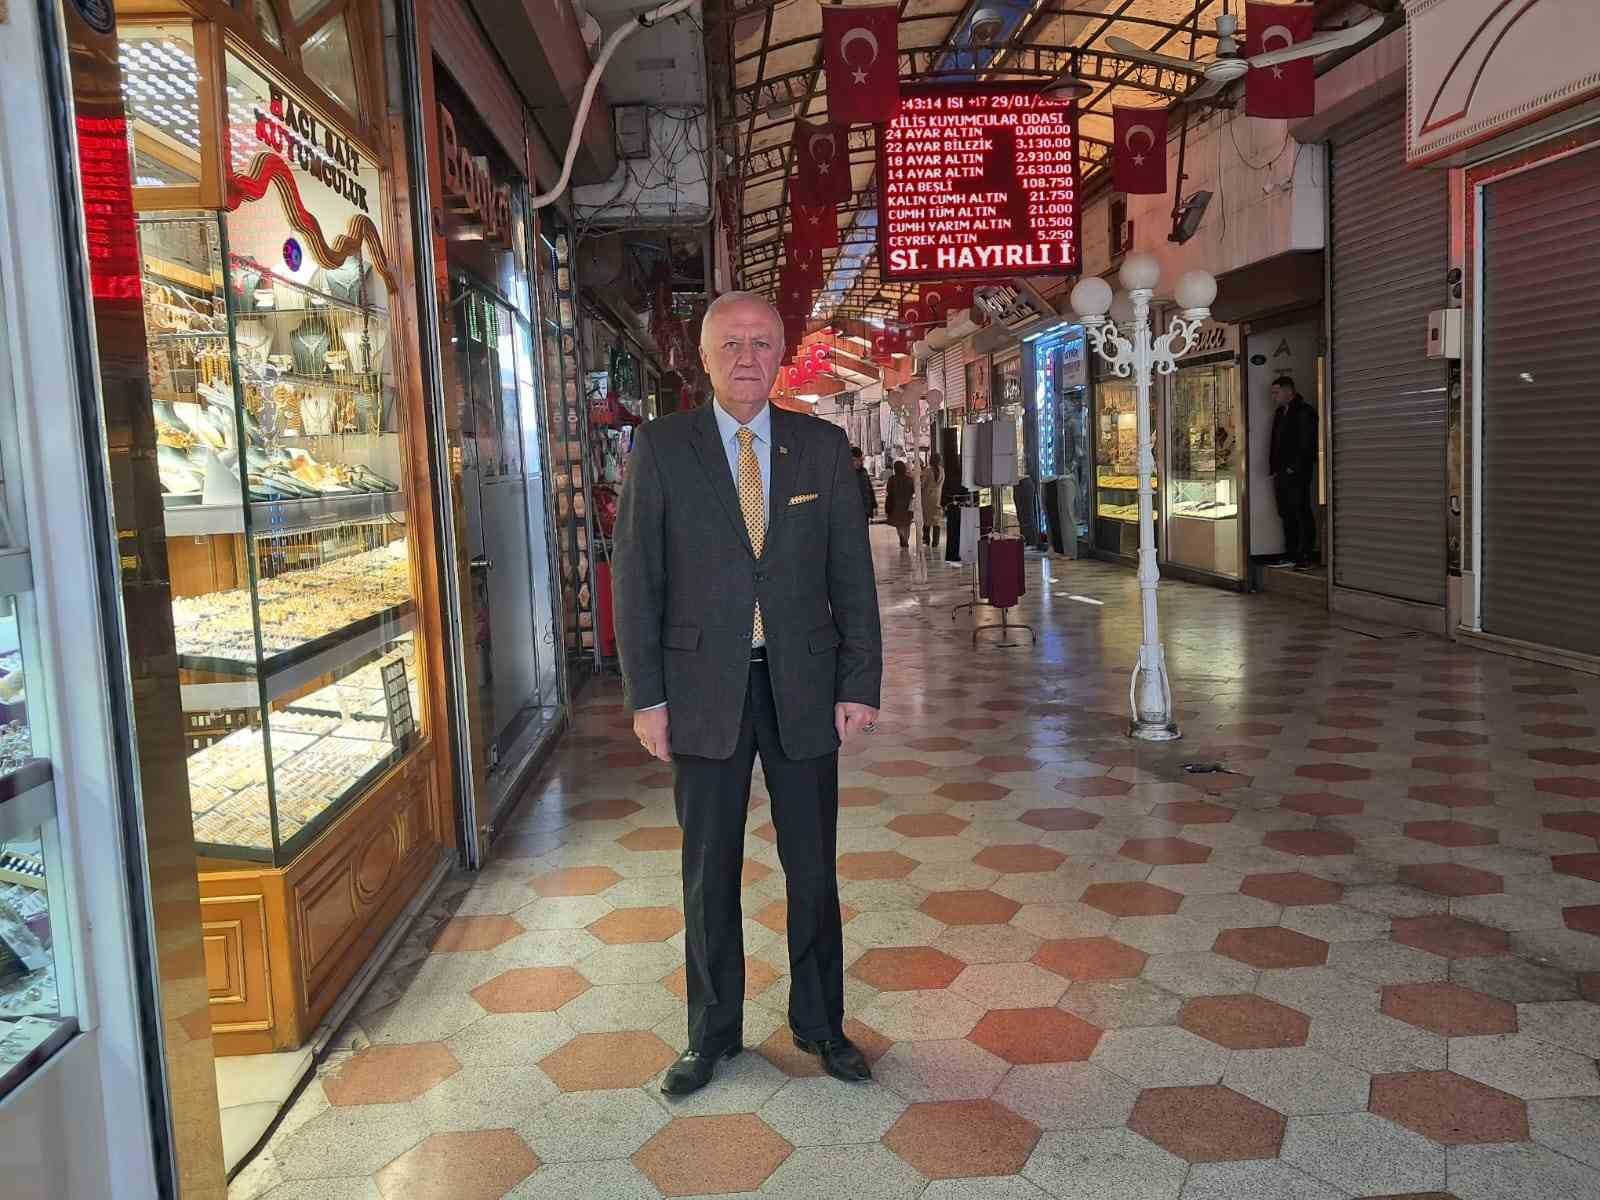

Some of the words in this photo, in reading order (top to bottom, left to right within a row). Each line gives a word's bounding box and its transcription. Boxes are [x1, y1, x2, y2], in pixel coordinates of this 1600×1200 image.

[891, 115, 927, 129] KİLİS
[929, 114, 1018, 127] KUYUMCULAR
[1022, 113, 1064, 125] ODASI
[886, 129, 902, 140] 24
[906, 128, 941, 139] AYAR
[944, 127, 983, 138] ALTIN
[886, 142, 902, 153] 22
[906, 141, 941, 151] AYAR
[944, 138, 993, 150] BİLEZİK
[1015, 138, 1071, 148] 3.130.00
[887, 155, 902, 166] 18
[906, 154, 941, 165] AYAR
[945, 153, 983, 165] ALTIN
[1016, 151, 1072, 162] 2.930.00
[887, 168, 903, 180] 14
[907, 167, 942, 178] AYAR
[945, 166, 984, 177] ALTIN
[1016, 164, 1072, 175] 2.630.00
[887, 182, 914, 193] ATA
[917, 180, 953, 194] BEŞLİ
[1022, 177, 1073, 189] 108.750
[888, 195, 927, 206] KALIN
[929, 194, 966, 205] CUMH
[969, 192, 1007, 203] ALTIN
[1030, 191, 1074, 201] 21.750
[888, 209, 925, 219] CUMH
[928, 205, 955, 218] TÜM
[958, 206, 996, 217] ALTIN
[1029, 204, 1073, 214] 21.000
[889, 222, 925, 233] CUMH
[928, 220, 970, 231] YARIM
[973, 219, 1012, 230] ALTIN
[1030, 217, 1073, 228] 10.500
[889, 235, 935, 247] ÇEYREK
[939, 233, 977, 244] ALTIN
[1037, 230, 1073, 240] 5.250
[890, 250, 928, 270] SI.
[937, 243, 1051, 268] HAYIRLI
